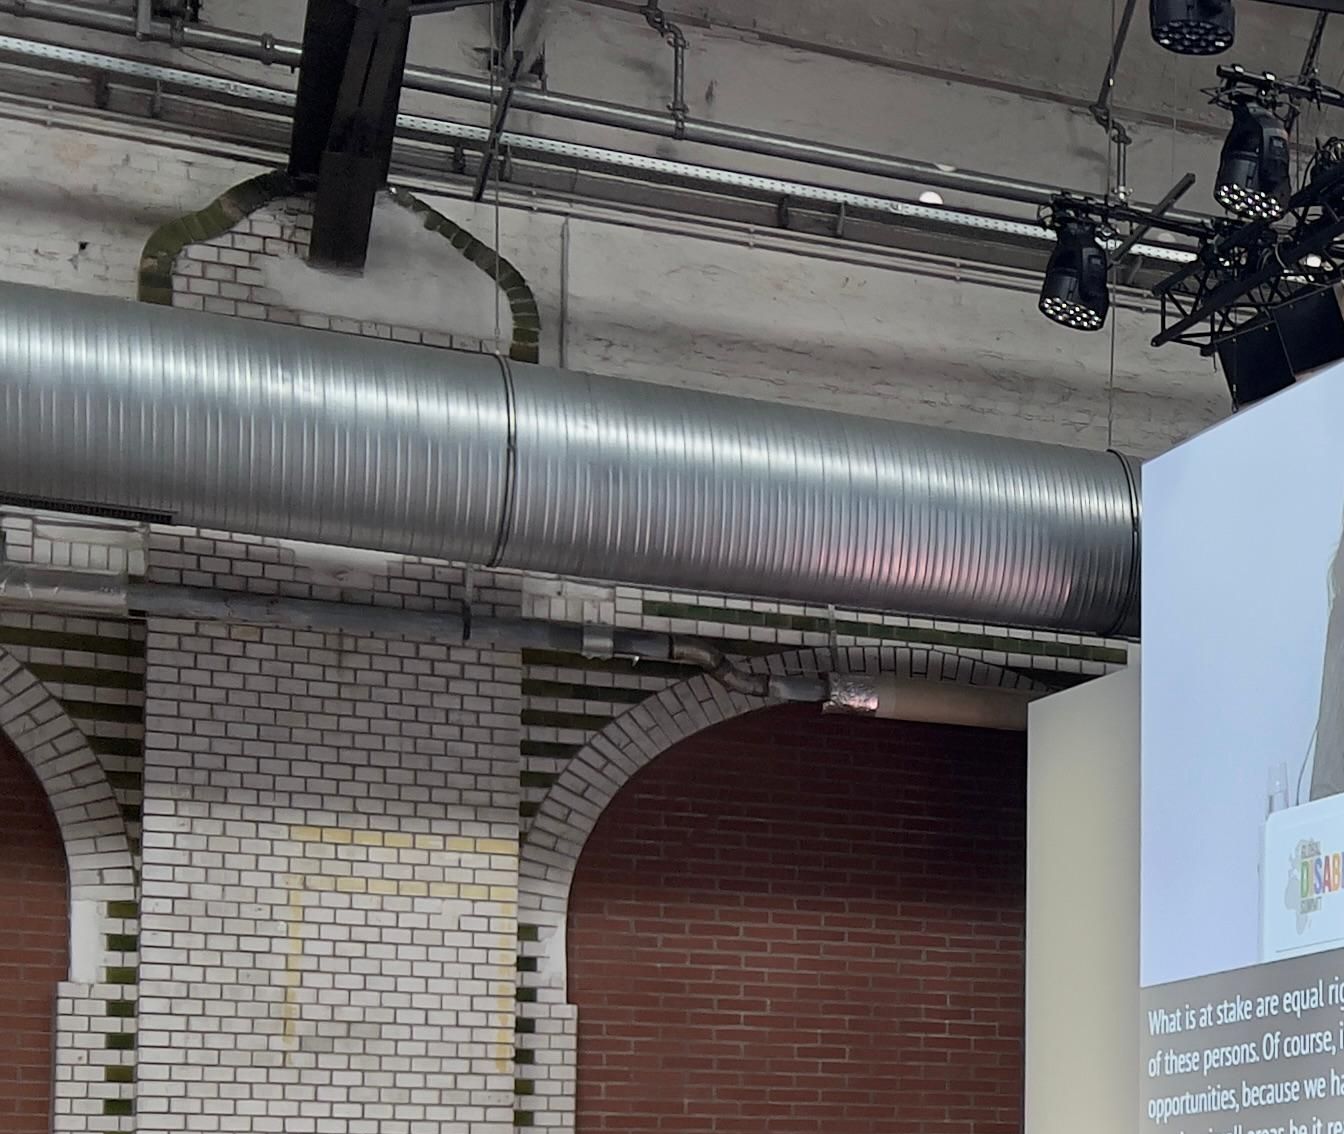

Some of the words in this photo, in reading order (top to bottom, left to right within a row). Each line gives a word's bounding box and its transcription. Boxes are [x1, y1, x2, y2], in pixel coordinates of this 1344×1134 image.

[1148, 1008, 1182, 1035] What
[1186, 1005, 1197, 1029] is
[1199, 1004, 1213, 1027] at
[1216, 995, 1252, 1024] stake
[1256, 995, 1279, 1017] are
[1283, 980, 1324, 1017] equal
[1148, 1050, 1162, 1077] of
[1164, 1049, 1200, 1073] these
[1203, 1043, 1260, 1075] persons.
[1262, 1032, 1282, 1060] Of
[1284, 1031, 1337, 1057] course,
[1148, 1085, 1240, 1123] opportunities,
[1243, 1080, 1300, 1108] because
[1304, 1077, 1326, 1099] we
